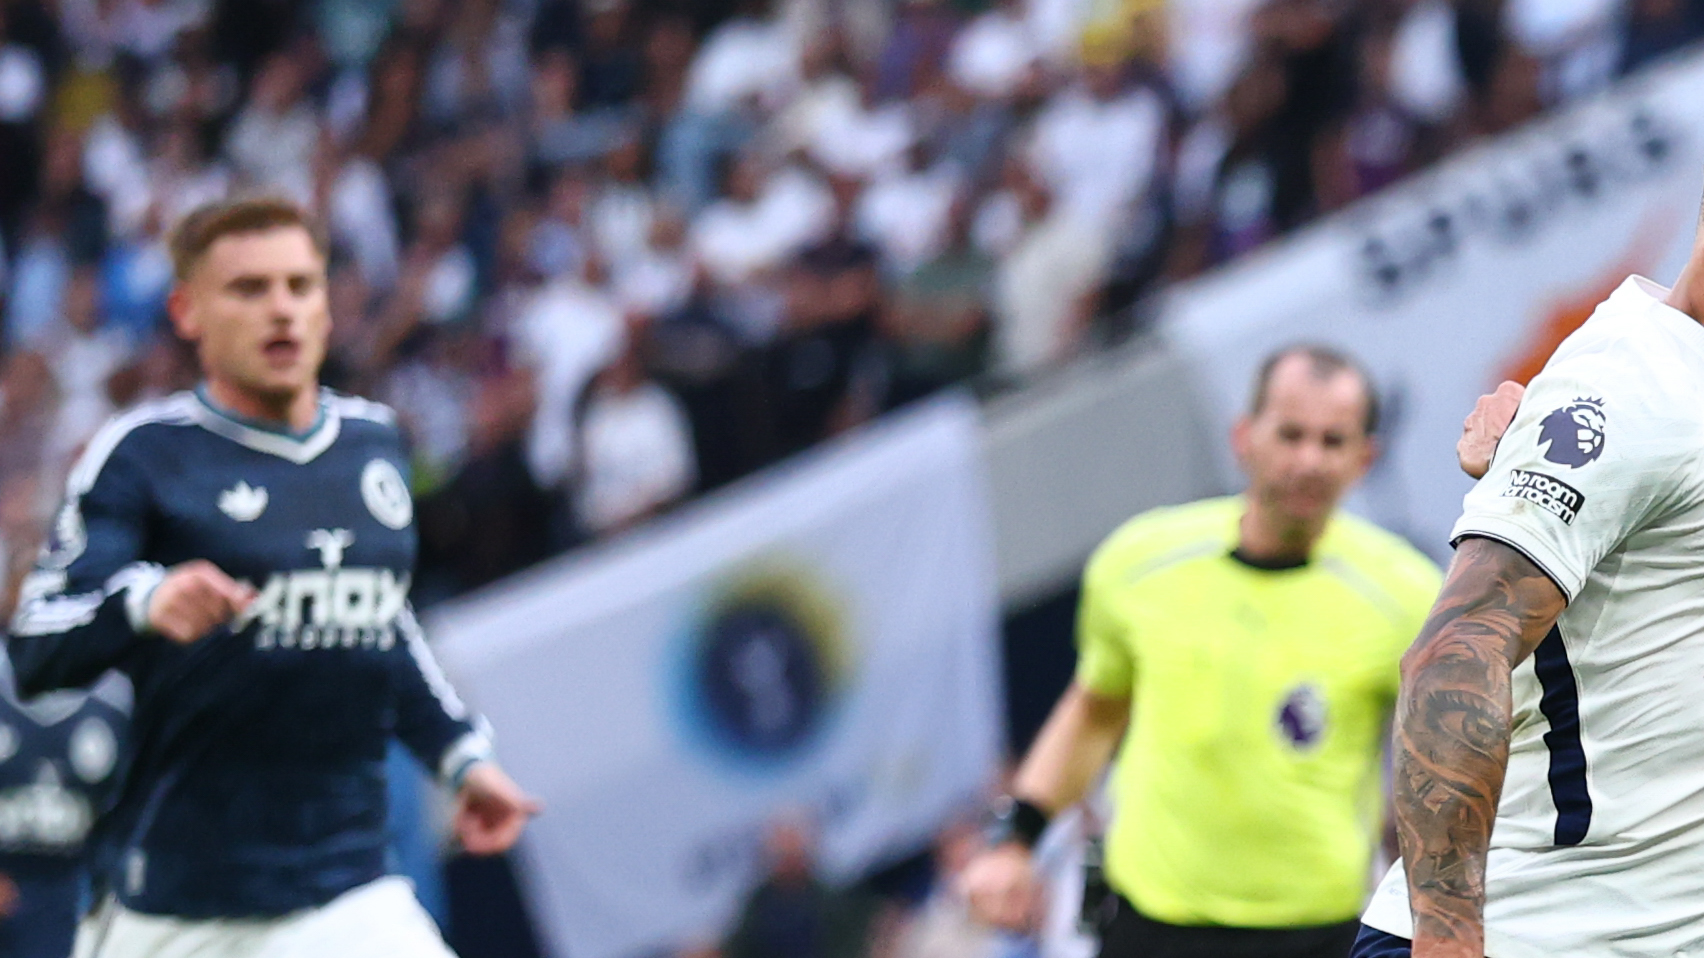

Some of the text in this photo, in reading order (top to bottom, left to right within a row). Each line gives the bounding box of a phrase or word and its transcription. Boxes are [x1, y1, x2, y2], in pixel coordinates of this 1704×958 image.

[1511, 470, 1578, 508] No room
[1519, 487, 1576, 525] racism
